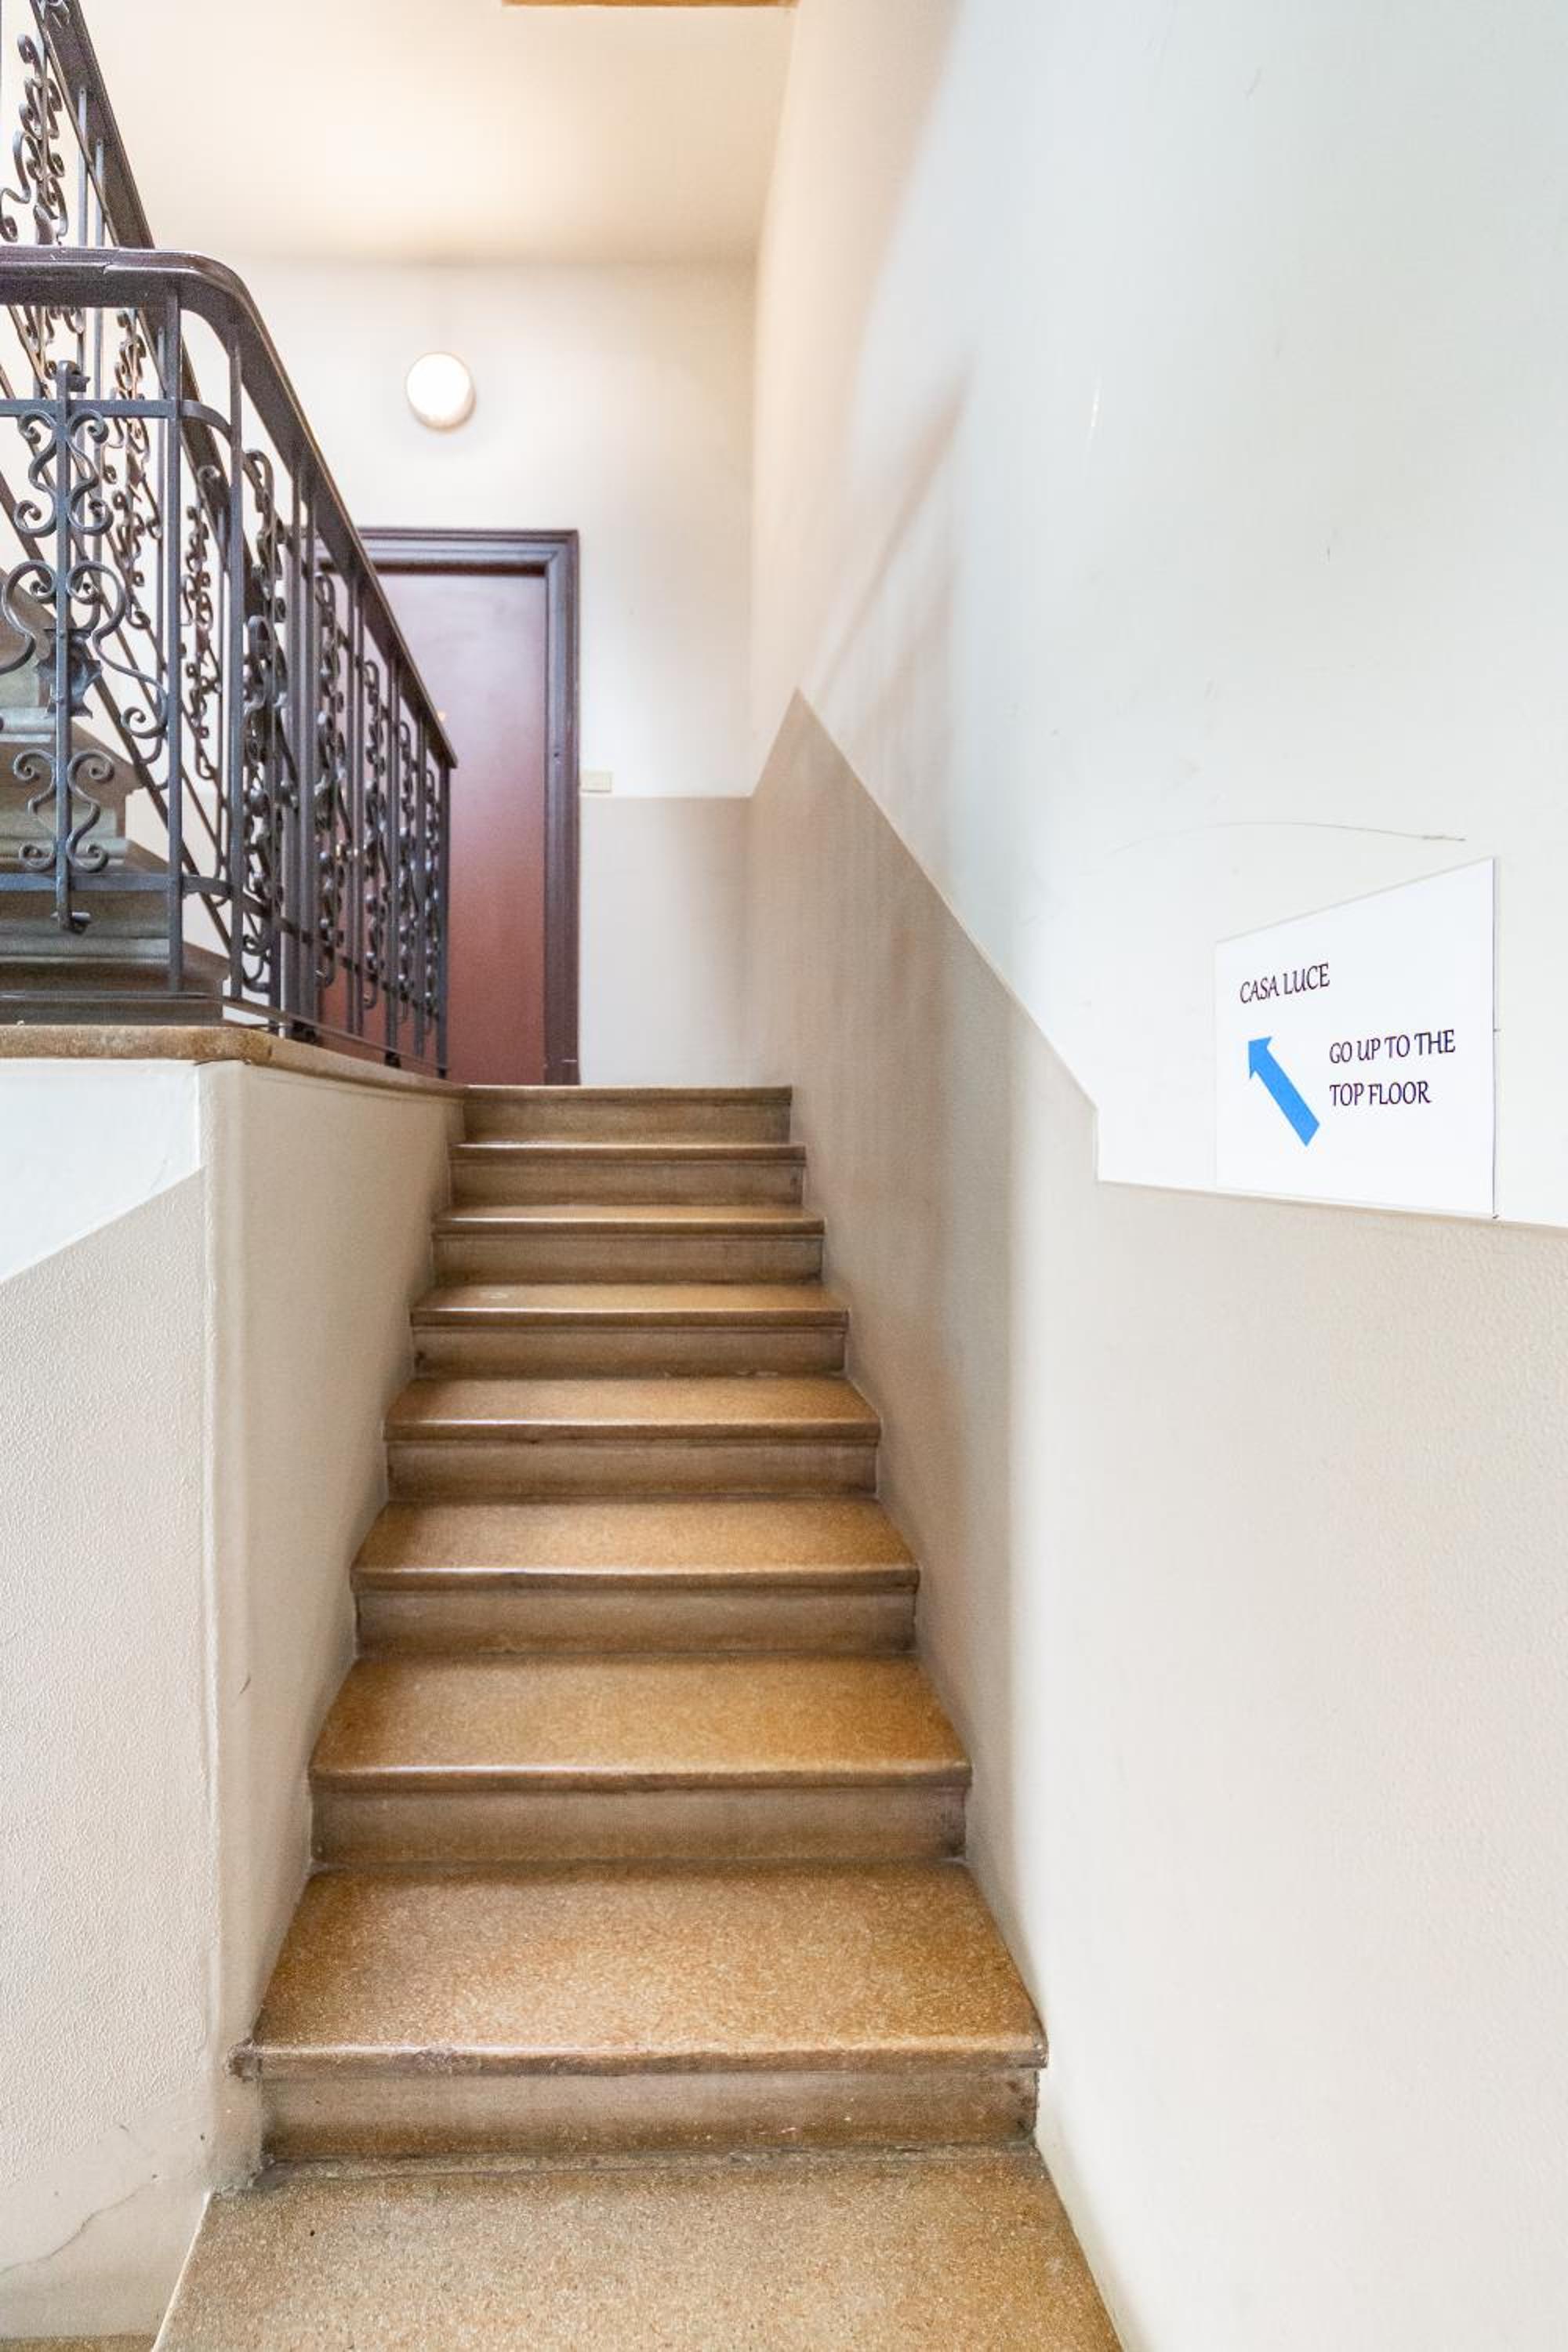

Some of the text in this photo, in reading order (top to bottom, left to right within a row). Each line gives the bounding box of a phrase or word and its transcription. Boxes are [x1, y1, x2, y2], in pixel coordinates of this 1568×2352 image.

[1240, 962, 1330, 1004] CASA LUCE
[1329, 1029, 1457, 1064] GO UP TO THE
[1329, 1080, 1432, 1106] TOP FLOOR
